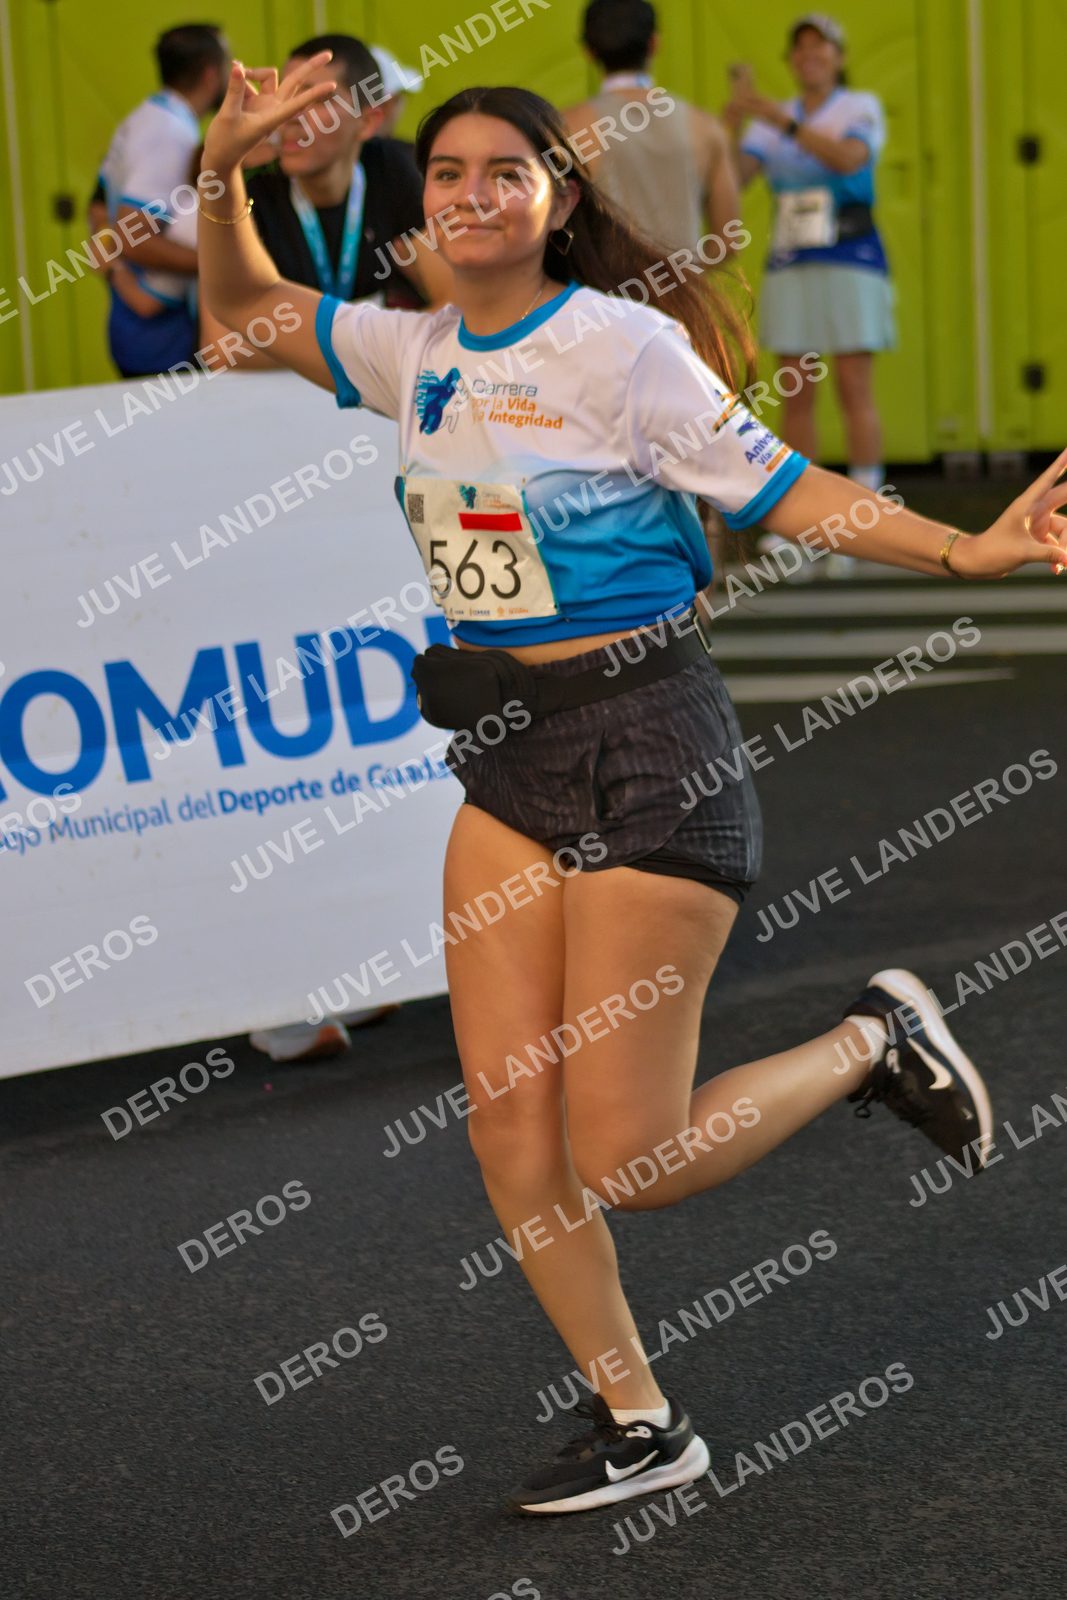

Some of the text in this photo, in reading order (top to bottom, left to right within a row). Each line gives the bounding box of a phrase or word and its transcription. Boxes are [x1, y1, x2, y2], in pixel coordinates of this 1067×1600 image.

[472, 379, 538, 397] Carrera
[507, 397, 536, 412] Vida
[488, 410, 563, 430] Integridad
[430, 539, 521, 599] 563
[0, 614, 452, 803] OMUD
[49, 796, 173, 843] Municipal
[178, 789, 218, 822] del
[218, 777, 323, 816] Deporte
[331, 768, 361, 796] de
